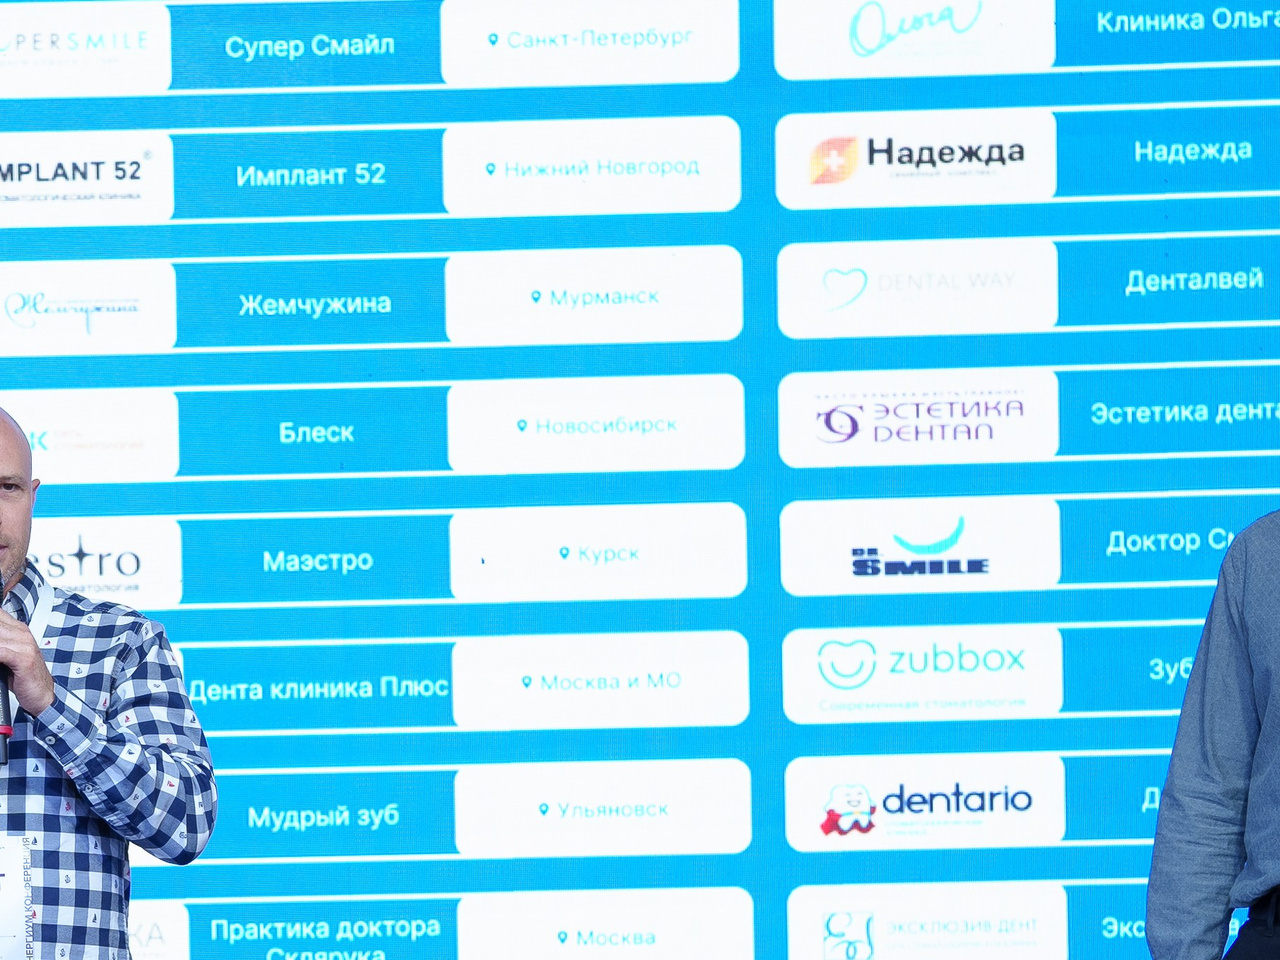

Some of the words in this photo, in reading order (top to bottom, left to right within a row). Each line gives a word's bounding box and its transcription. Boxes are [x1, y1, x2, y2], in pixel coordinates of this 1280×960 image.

[1098, 12, 1204, 32] Клиника
[226, 36, 304, 62] Супер
[311, 34, 394, 56] Смайл
[507, 28, 692, 49] Санкт-Петербург
[868, 138, 1024, 169] Надежда
[1135, 141, 1251, 163] Надежда
[237, 166, 347, 186] Имплант
[356, 163, 385, 183] 52
[505, 160, 589, 177] Нижний
[597, 160, 700, 177] Новгород
[1125, 268, 1263, 296] Денталвей
[239, 295, 391, 318] Жемчужина
[551, 290, 658, 308] Мурманск
[875, 401, 1023, 420] ЭСТЕТИКА
[1092, 402, 1208, 424] Эстетика
[280, 422, 353, 443] Блеск
[536, 417, 676, 435] Новосибирск
[1106, 531, 1200, 556] Доктор
[264, 551, 373, 574] Маэстро
[579, 548, 638, 565] Курск
[853, 559, 989, 576] SMILE
[889, 642, 1024, 674] zubbox
[189, 680, 262, 705] Дента
[271, 681, 372, 698] клиника
[381, 676, 448, 696] Плюс
[541, 675, 620, 690] Москва
[628, 677, 639, 688] и
[647, 672, 681, 688] МО
[883, 782, 1032, 814] dentario
[249, 806, 349, 832] Мудрый
[358, 803, 399, 830] зуб
[558, 803, 668, 818] Ульяновск
[211, 919, 329, 944] Практика
[336, 919, 440, 941] доктора
[577, 930, 656, 946] Москва
